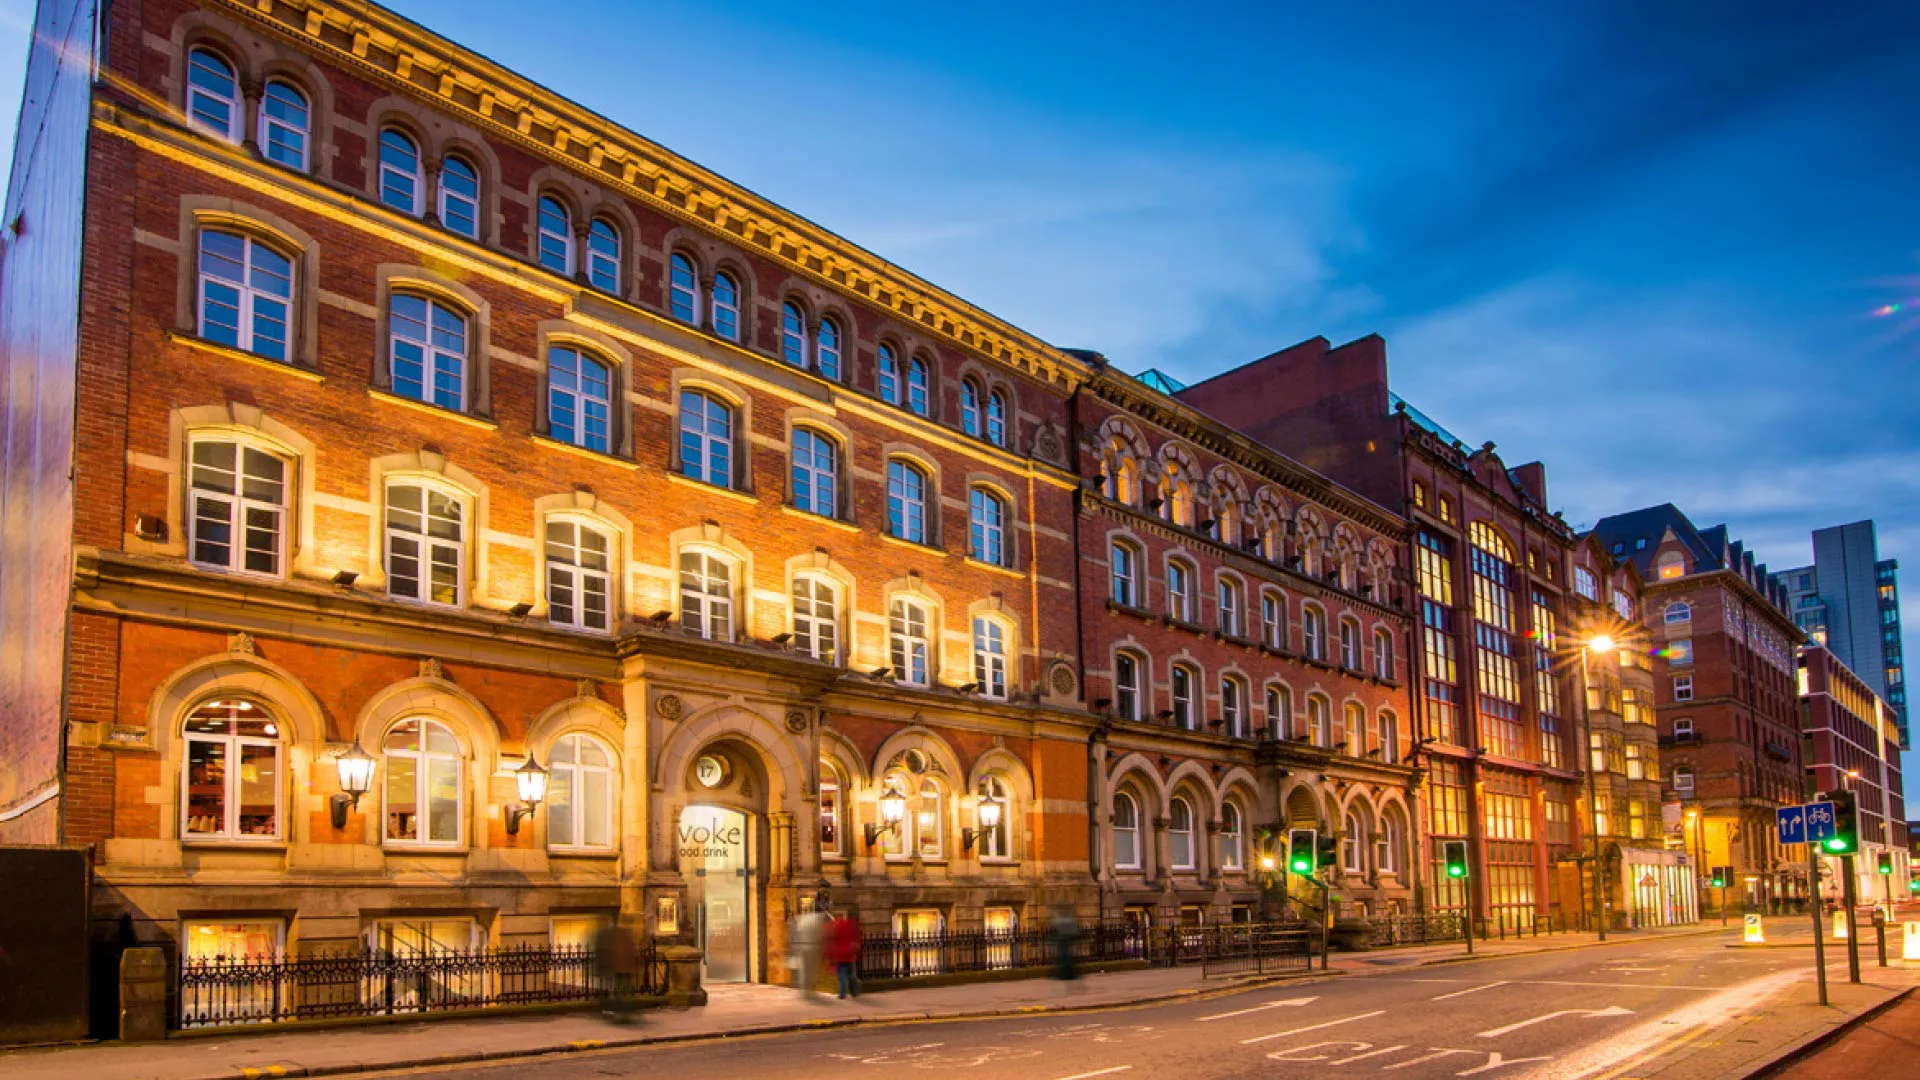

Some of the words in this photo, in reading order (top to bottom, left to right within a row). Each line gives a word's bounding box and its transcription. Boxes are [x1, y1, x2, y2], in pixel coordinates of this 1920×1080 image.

[701, 764, 714, 778] 17
[703, 847, 729, 858] drink
[1266, 1041, 1553, 1076] CITY
